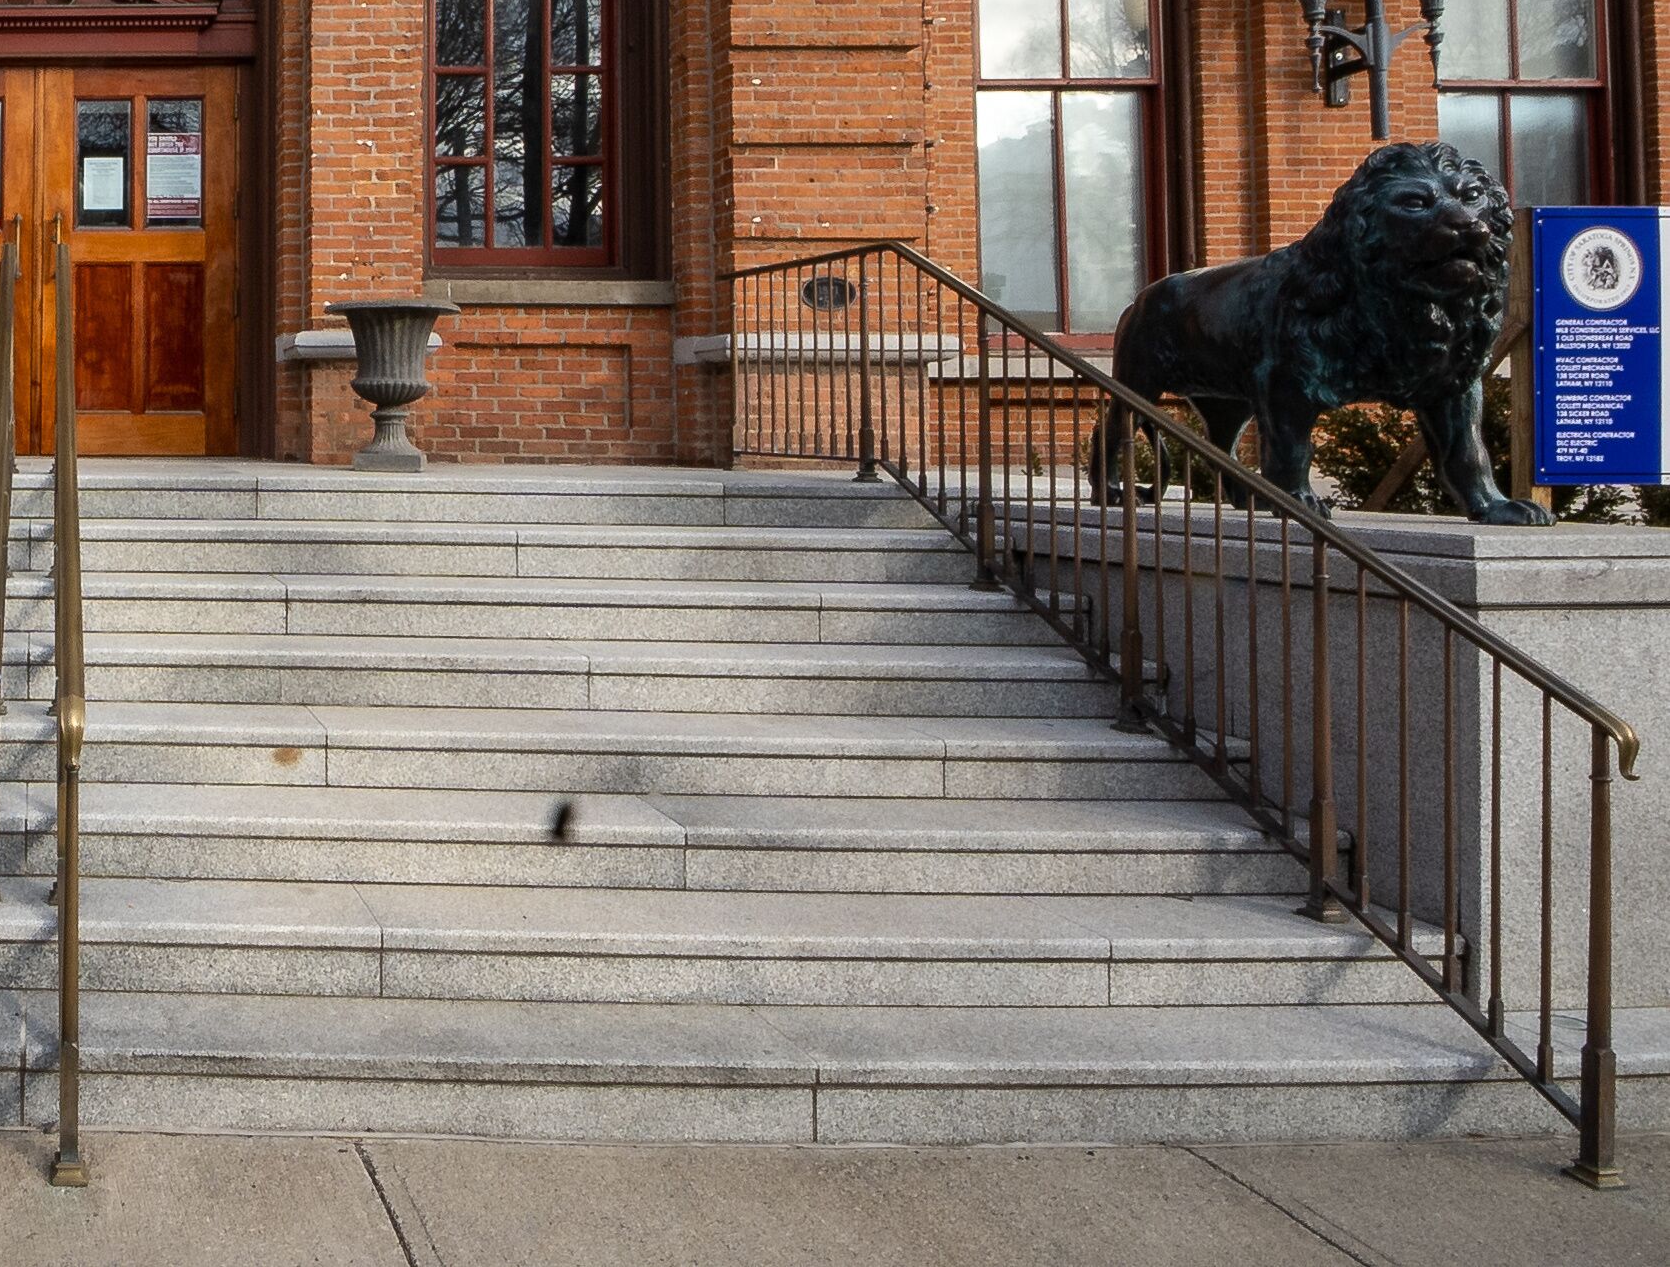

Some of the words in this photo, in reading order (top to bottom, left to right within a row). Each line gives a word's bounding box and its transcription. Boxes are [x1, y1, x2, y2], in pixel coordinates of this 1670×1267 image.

[1555, 318, 1584, 326] GENERAL
[1584, 318, 1628, 326] CONTRACTOR
[1569, 326, 1618, 334] CONSTRUCTION
[1614, 334, 1634, 342] ROAD
[1555, 342, 1587, 350] BALLSTON
[1601, 342, 1612, 350] NY
[1555, 356, 1575, 364] HVAC
[1575, 356, 1619, 364] CONTRACTOR
[1581, 364, 1624, 372] MECHANICAL
[1590, 372, 1610, 380] ROAD
[1583, 380, 1594, 388] NY
[1555, 394, 1589, 402] PLUMBING
[1588, 394, 1632, 402] CONTRACTOR
[1581, 402, 1624, 410] MECHANICAL
[1556, 431, 1592, 439] ELECTRICAL
[1591, 431, 1635, 439] CONTRACTOR
[1569, 439, 1599, 447] ELECTRIC
